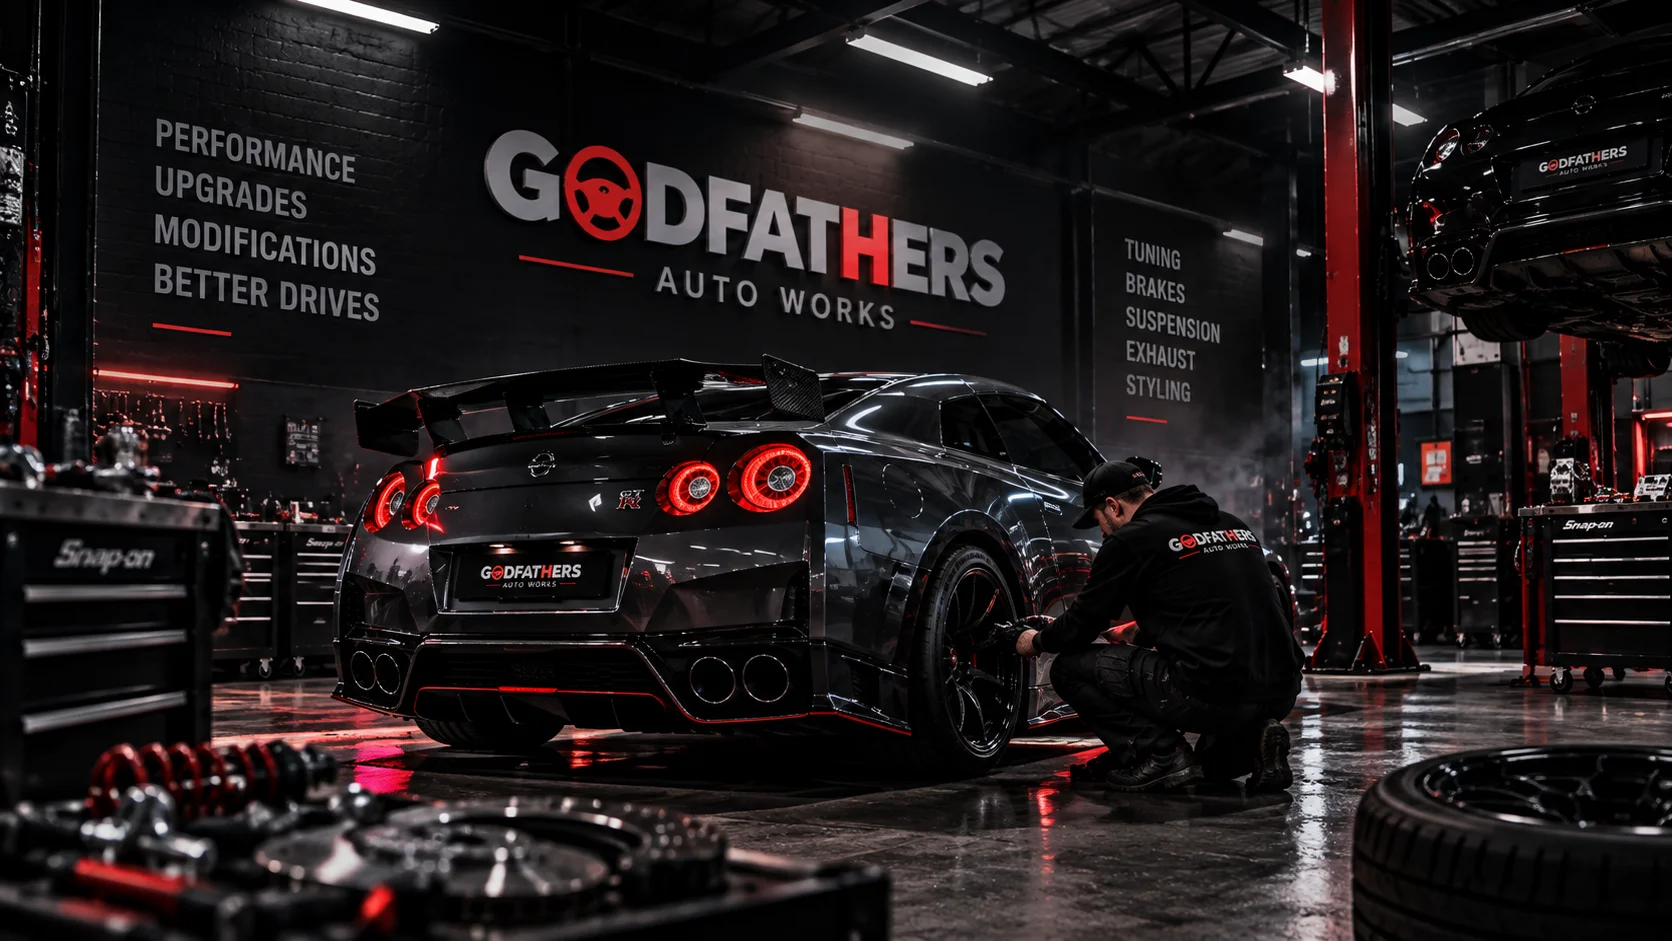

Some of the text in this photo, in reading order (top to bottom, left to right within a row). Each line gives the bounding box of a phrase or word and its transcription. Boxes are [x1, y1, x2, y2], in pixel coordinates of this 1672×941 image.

[155, 118, 356, 184] PERFORMANCE
[1538, 145, 1628, 173] GODFATHERS
[155, 165, 308, 219] UPGRADES
[484, 129, 1006, 308] GODFATHERS
[154, 213, 377, 276] MODIFICATIONS
[1124, 237, 1181, 271] TUNING
[154, 262, 380, 322] BETTER DRIVES
[655, 266, 896, 330] AUTO WORKS
[1125, 271, 1186, 304] BRAKES
[1125, 305, 1221, 344] SUSPENSION
[1126, 339, 1197, 371] EXHAUST
[1126, 373, 1192, 403] STYLING
[1562, 519, 1615, 532] Snap-on
[52, 538, 156, 576] Snap-on
[480, 564, 582, 581] GODFATHERS
[502, 581, 524, 589] AUTO
